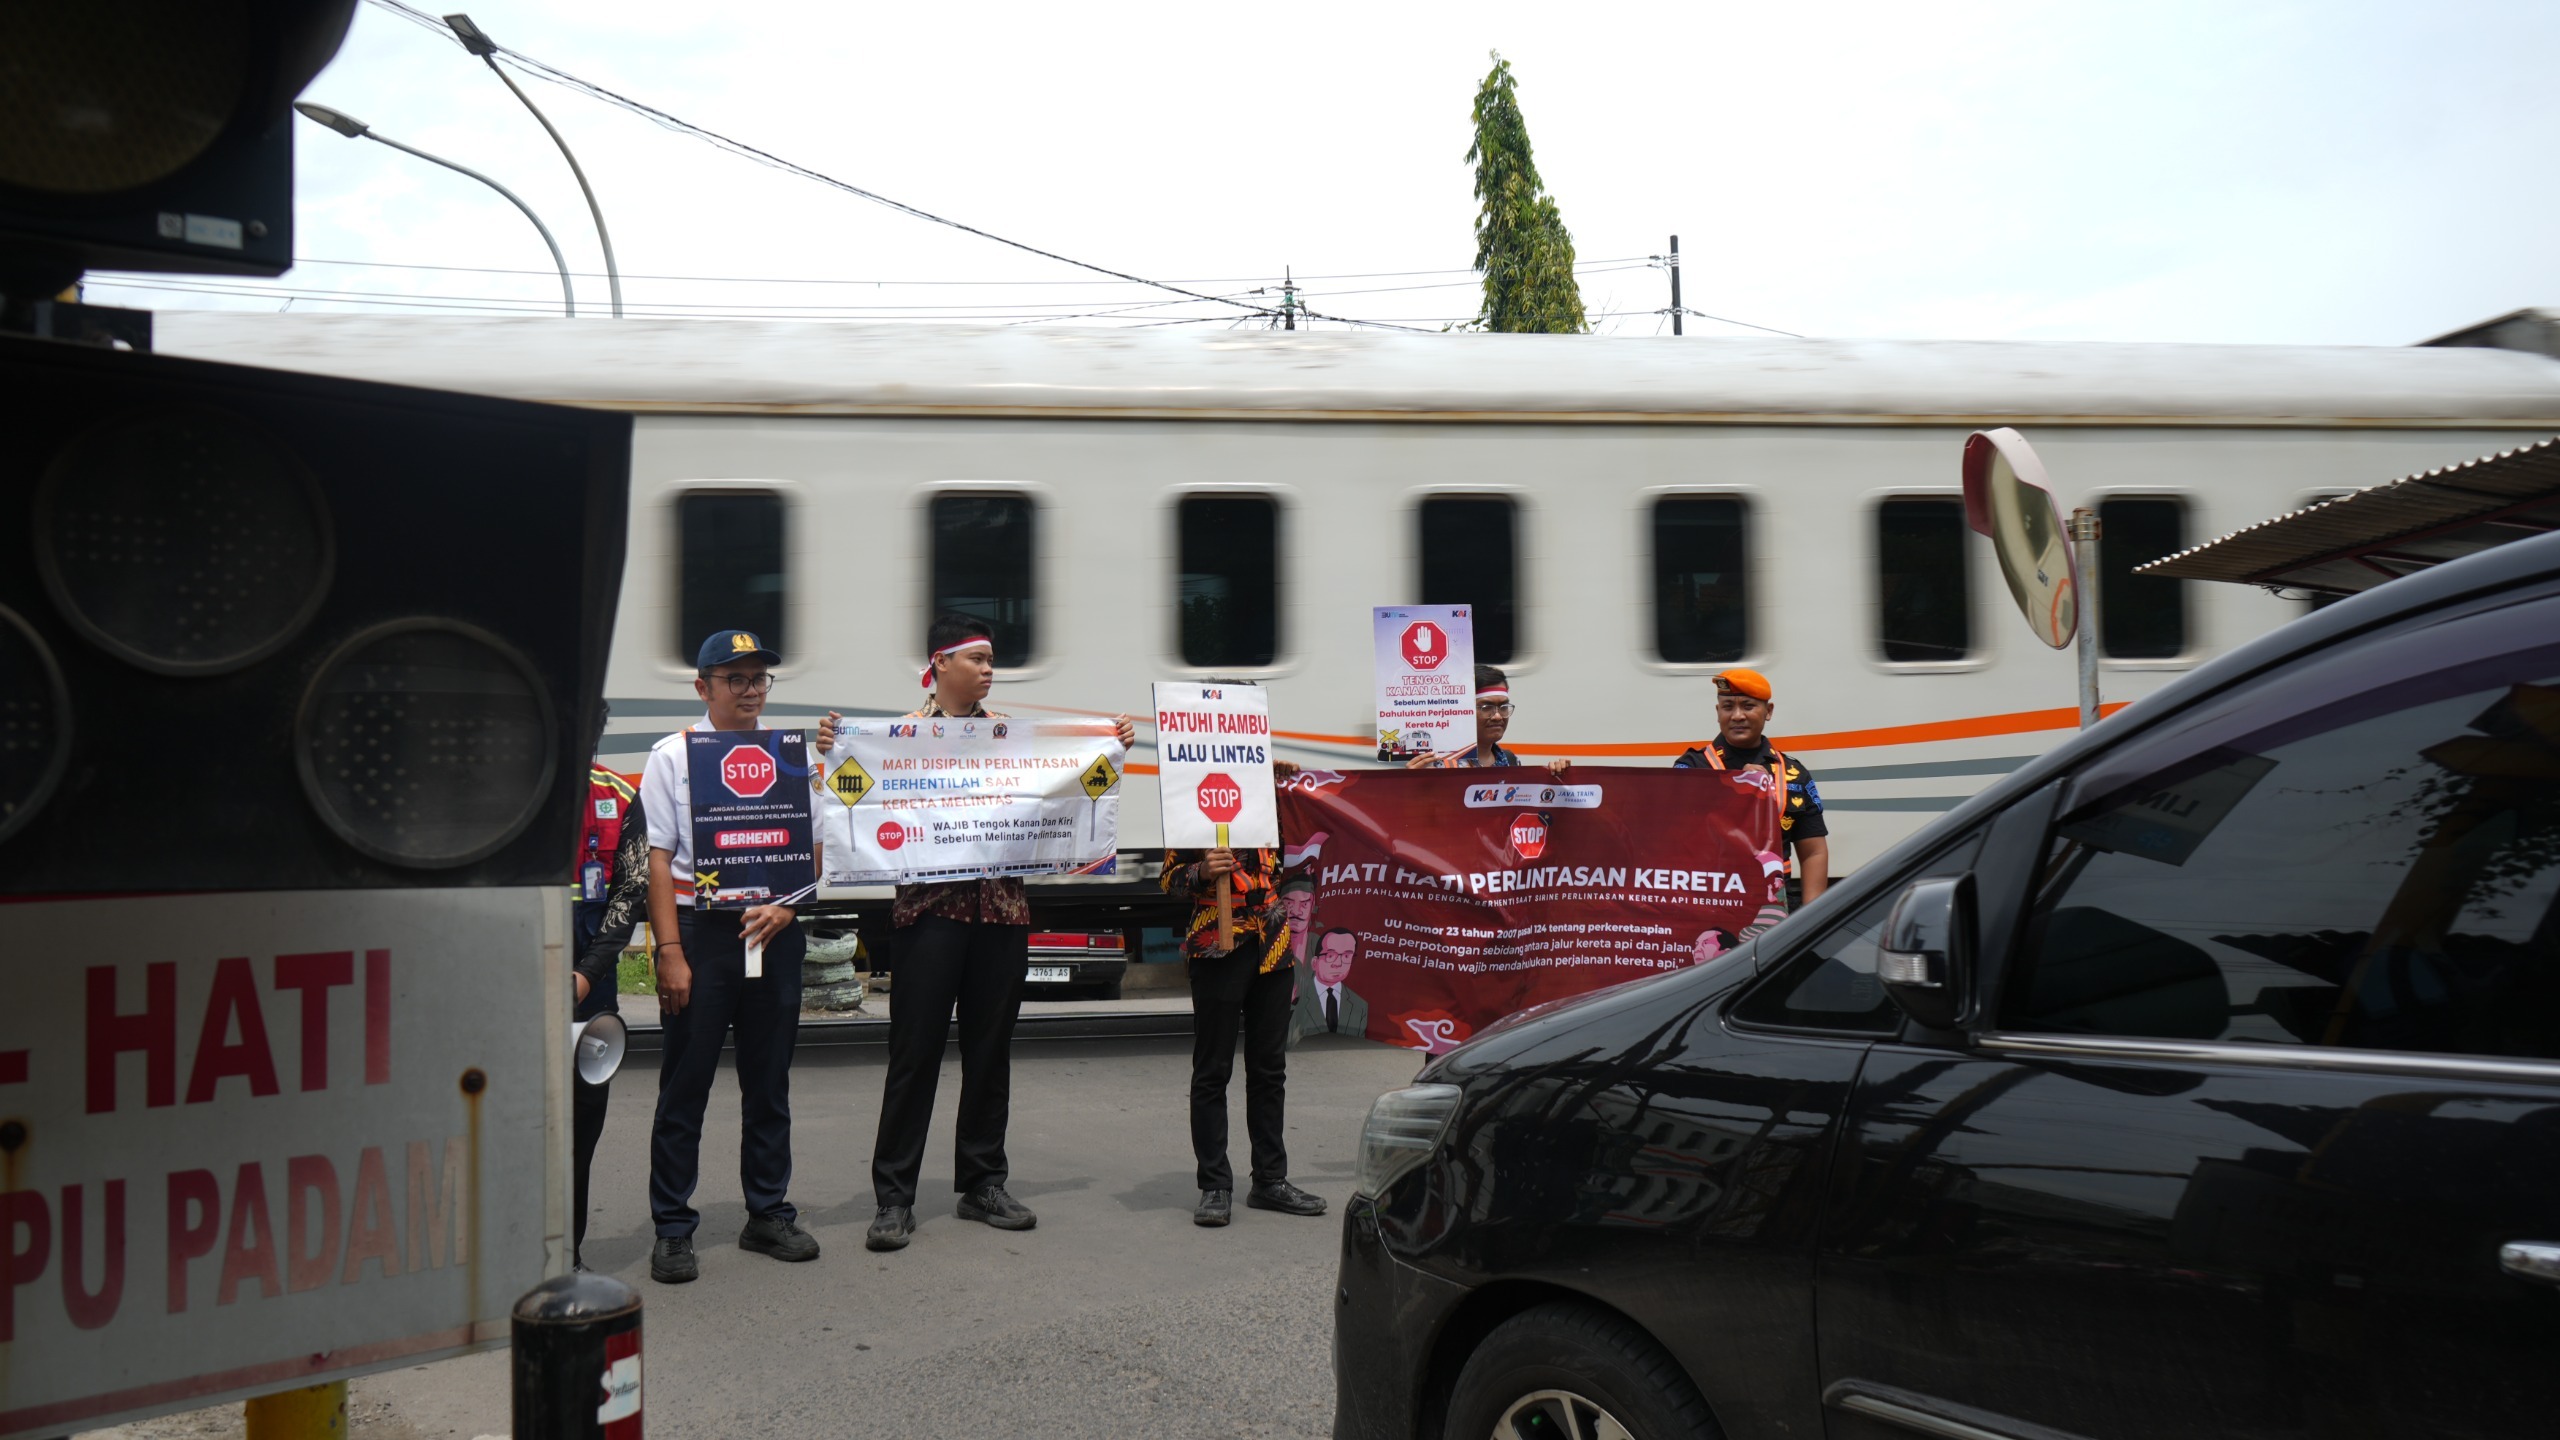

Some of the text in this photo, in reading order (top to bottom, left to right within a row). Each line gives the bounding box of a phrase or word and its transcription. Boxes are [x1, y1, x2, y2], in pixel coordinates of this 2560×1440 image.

[1412, 655, 1438, 665] STOP
[1402, 675, 1449, 685] TENGOK
[1386, 685, 1466, 697] KANAN & KIRI
[1427, 698, 1459, 706] Melintas
[1379, 708, 1474, 718] Dahulukan Perjalanan
[1159, 711, 1268, 736] PATUHI RAMBU
[1405, 720, 1450, 730] Kereta Api
[1167, 743, 1265, 764] LALU LINTAS
[726, 762, 771, 780] STOP
[882, 757, 1079, 770] MARI DISIPLIN PERLINTASAN
[882, 776, 1021, 791] BERHENTILAH SAAT
[882, 795, 1013, 810] KERETA MELINTAS
[1200, 788, 1240, 808] STOP
[736, 804, 769, 812] GADAIKAN
[764, 812, 808, 820] PERLINTASAN
[933, 816, 1074, 831] WAJIB Tengok Kanan Dan Kiri
[720, 831, 784, 846] BERHENTI
[879, 832, 903, 840] STOP
[934, 830, 1072, 845] Sebelum Melintas Perlintasan
[1514, 826, 1544, 844] STOP
[697, 853, 811, 866] SAAT KERETA MELINTAS
[1320, 863, 1746, 894] HATI HATI PERLINTASAN KERETA
[1320, 887, 1743, 908] JADILAH PAHLAWAN DENGAN BERHENTI SAAT SIRINE PERLINTASAN KERETA API BERBUNYI
[1384, 918, 1672, 939] UU nomor 23 tahun 2007 pasal 124 tentang perkeretaapian
[1398, 936, 1480, 957] perpotongan
[1482, 943, 1524, 957] sebidang
[1524, 941, 1549, 952] antara
[1551, 939, 1574, 953] jalur
[1576, 938, 1612, 950] kereta
[1614, 939, 1633, 952] api
[1635, 940, 1659, 952] dan
[1365, 950, 1421, 965] pemakai
[1422, 955, 1454, 971] jalan
[1457, 959, 1487, 974] wajib
[1489, 957, 1553, 972] mendahulukan
[1555, 955, 1612, 969] perjalanan
[1615, 955, 1654, 968] kereta
[86, 948, 391, 1115] HATI
[166, 1136, 468, 1315] PADAM
